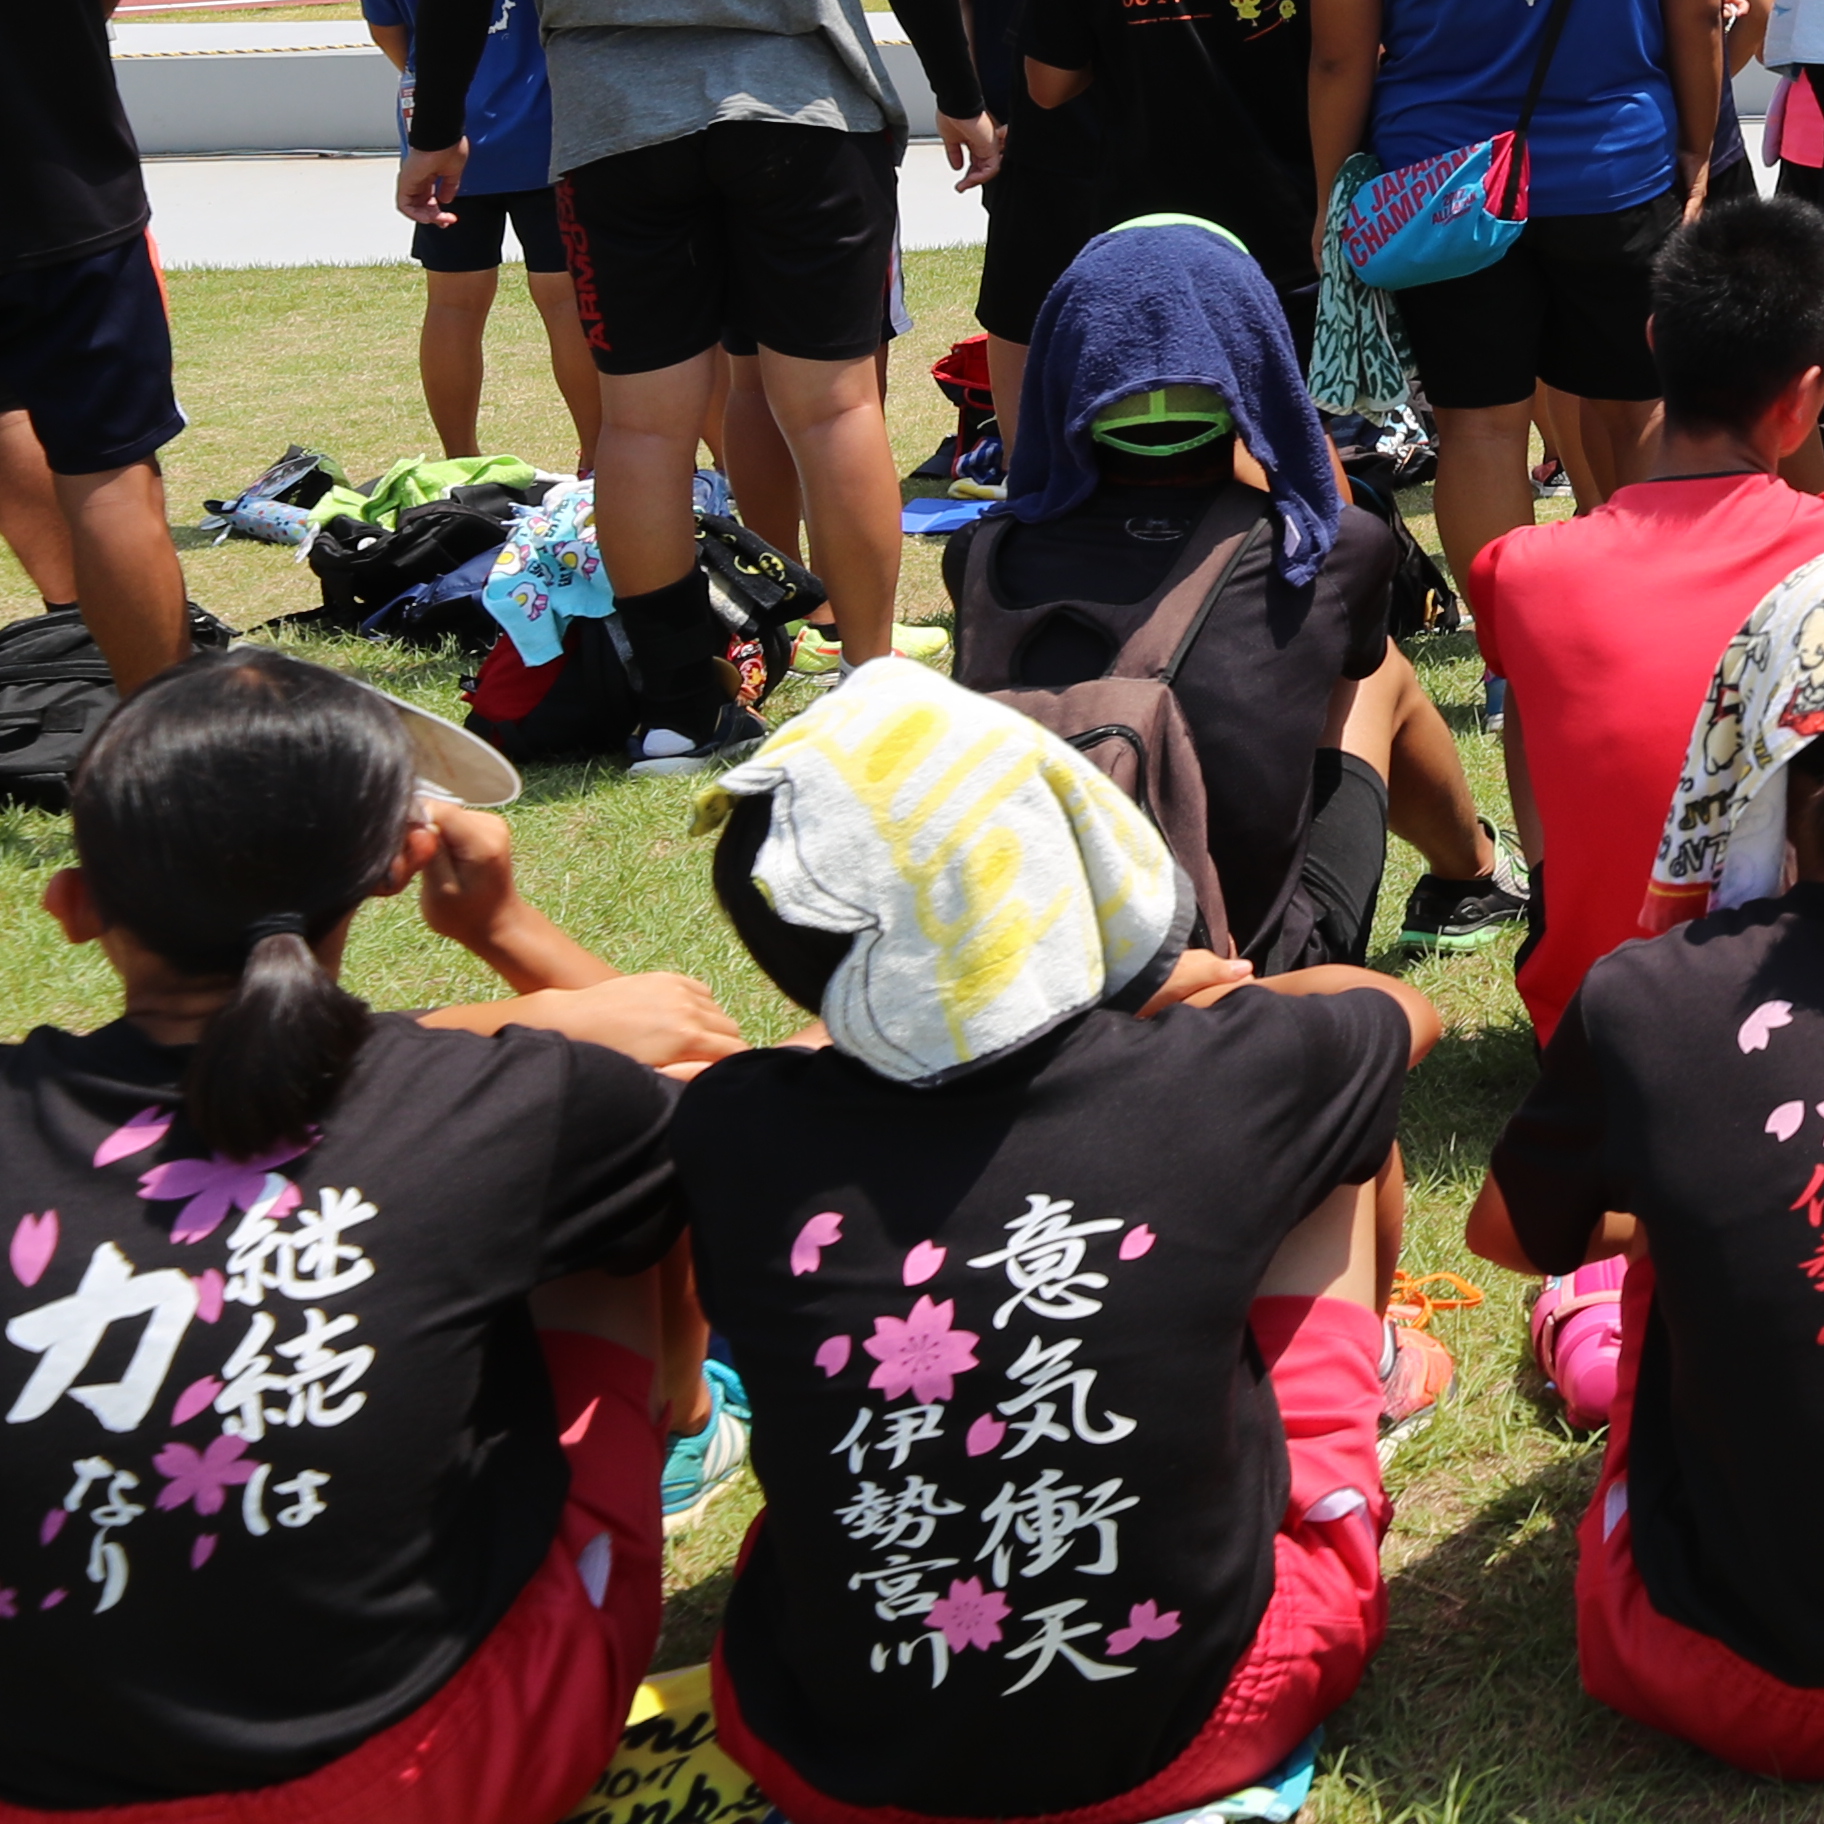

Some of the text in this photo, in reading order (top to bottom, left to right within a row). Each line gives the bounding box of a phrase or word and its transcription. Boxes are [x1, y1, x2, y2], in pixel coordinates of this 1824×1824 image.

[2, 1240, 196, 1434] 力
[221, 1185, 379, 1538] 継続は
[966, 1192, 1142, 1699] 意気衝天
[62, 1453, 147, 1617] なり
[830, 1404, 967, 1693] 伊勢宮川
